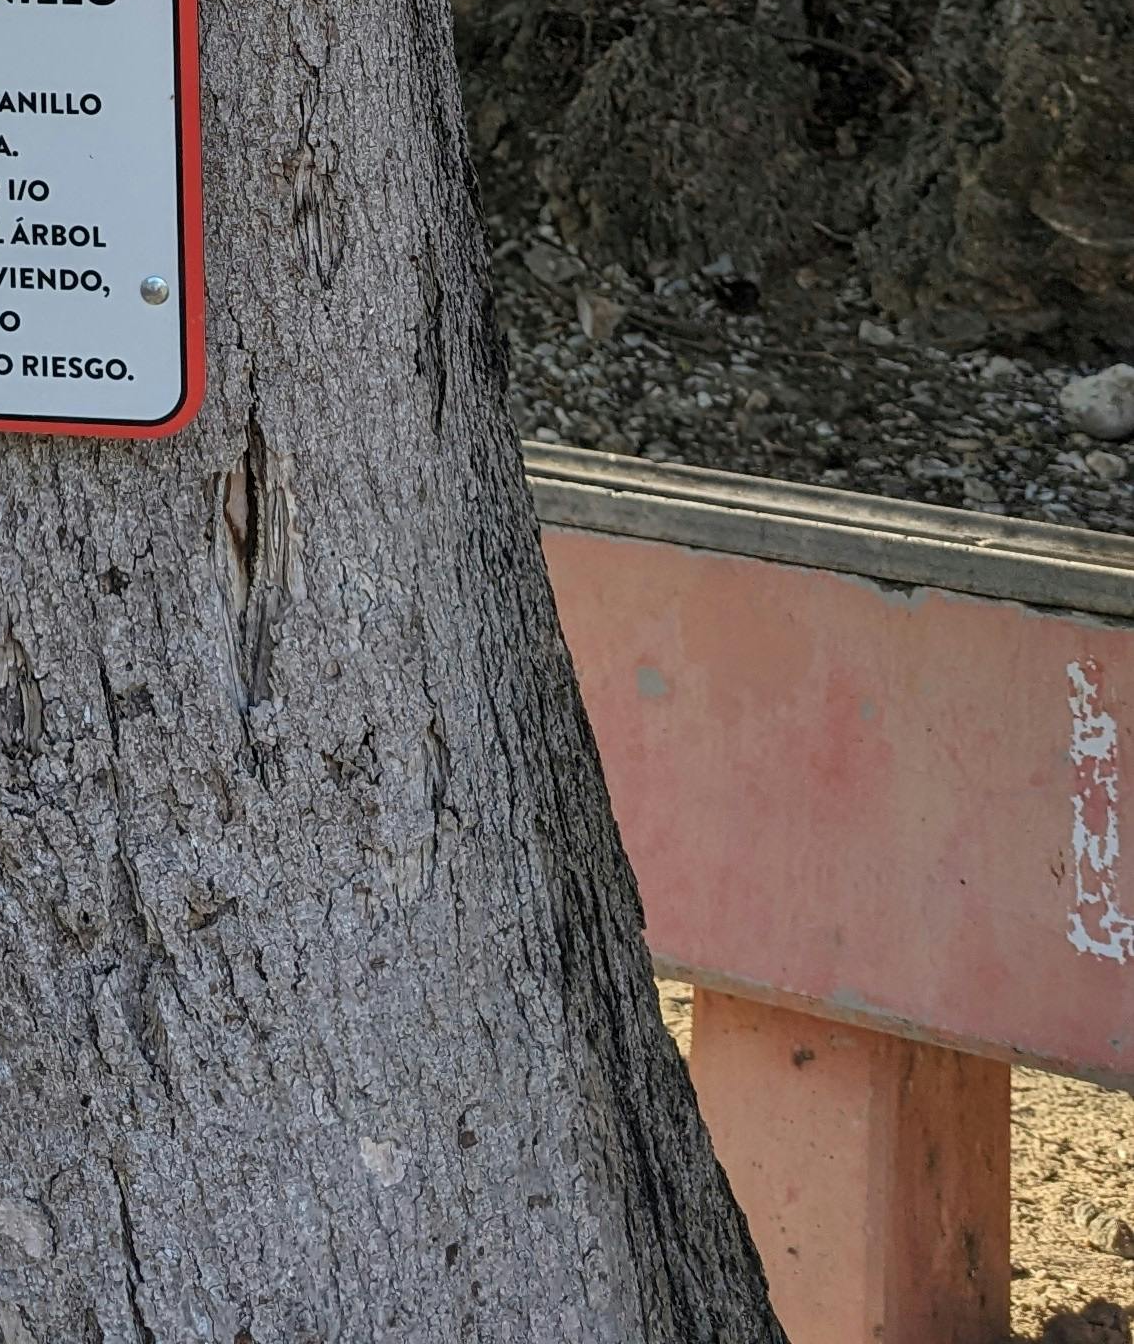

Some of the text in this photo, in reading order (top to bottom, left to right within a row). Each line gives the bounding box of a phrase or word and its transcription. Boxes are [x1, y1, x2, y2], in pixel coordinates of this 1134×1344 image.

[8, 178, 50, 202] I/O
[10, 216, 107, 248] ÁRBOL
[22, 354, 135, 381] RIESGO.
